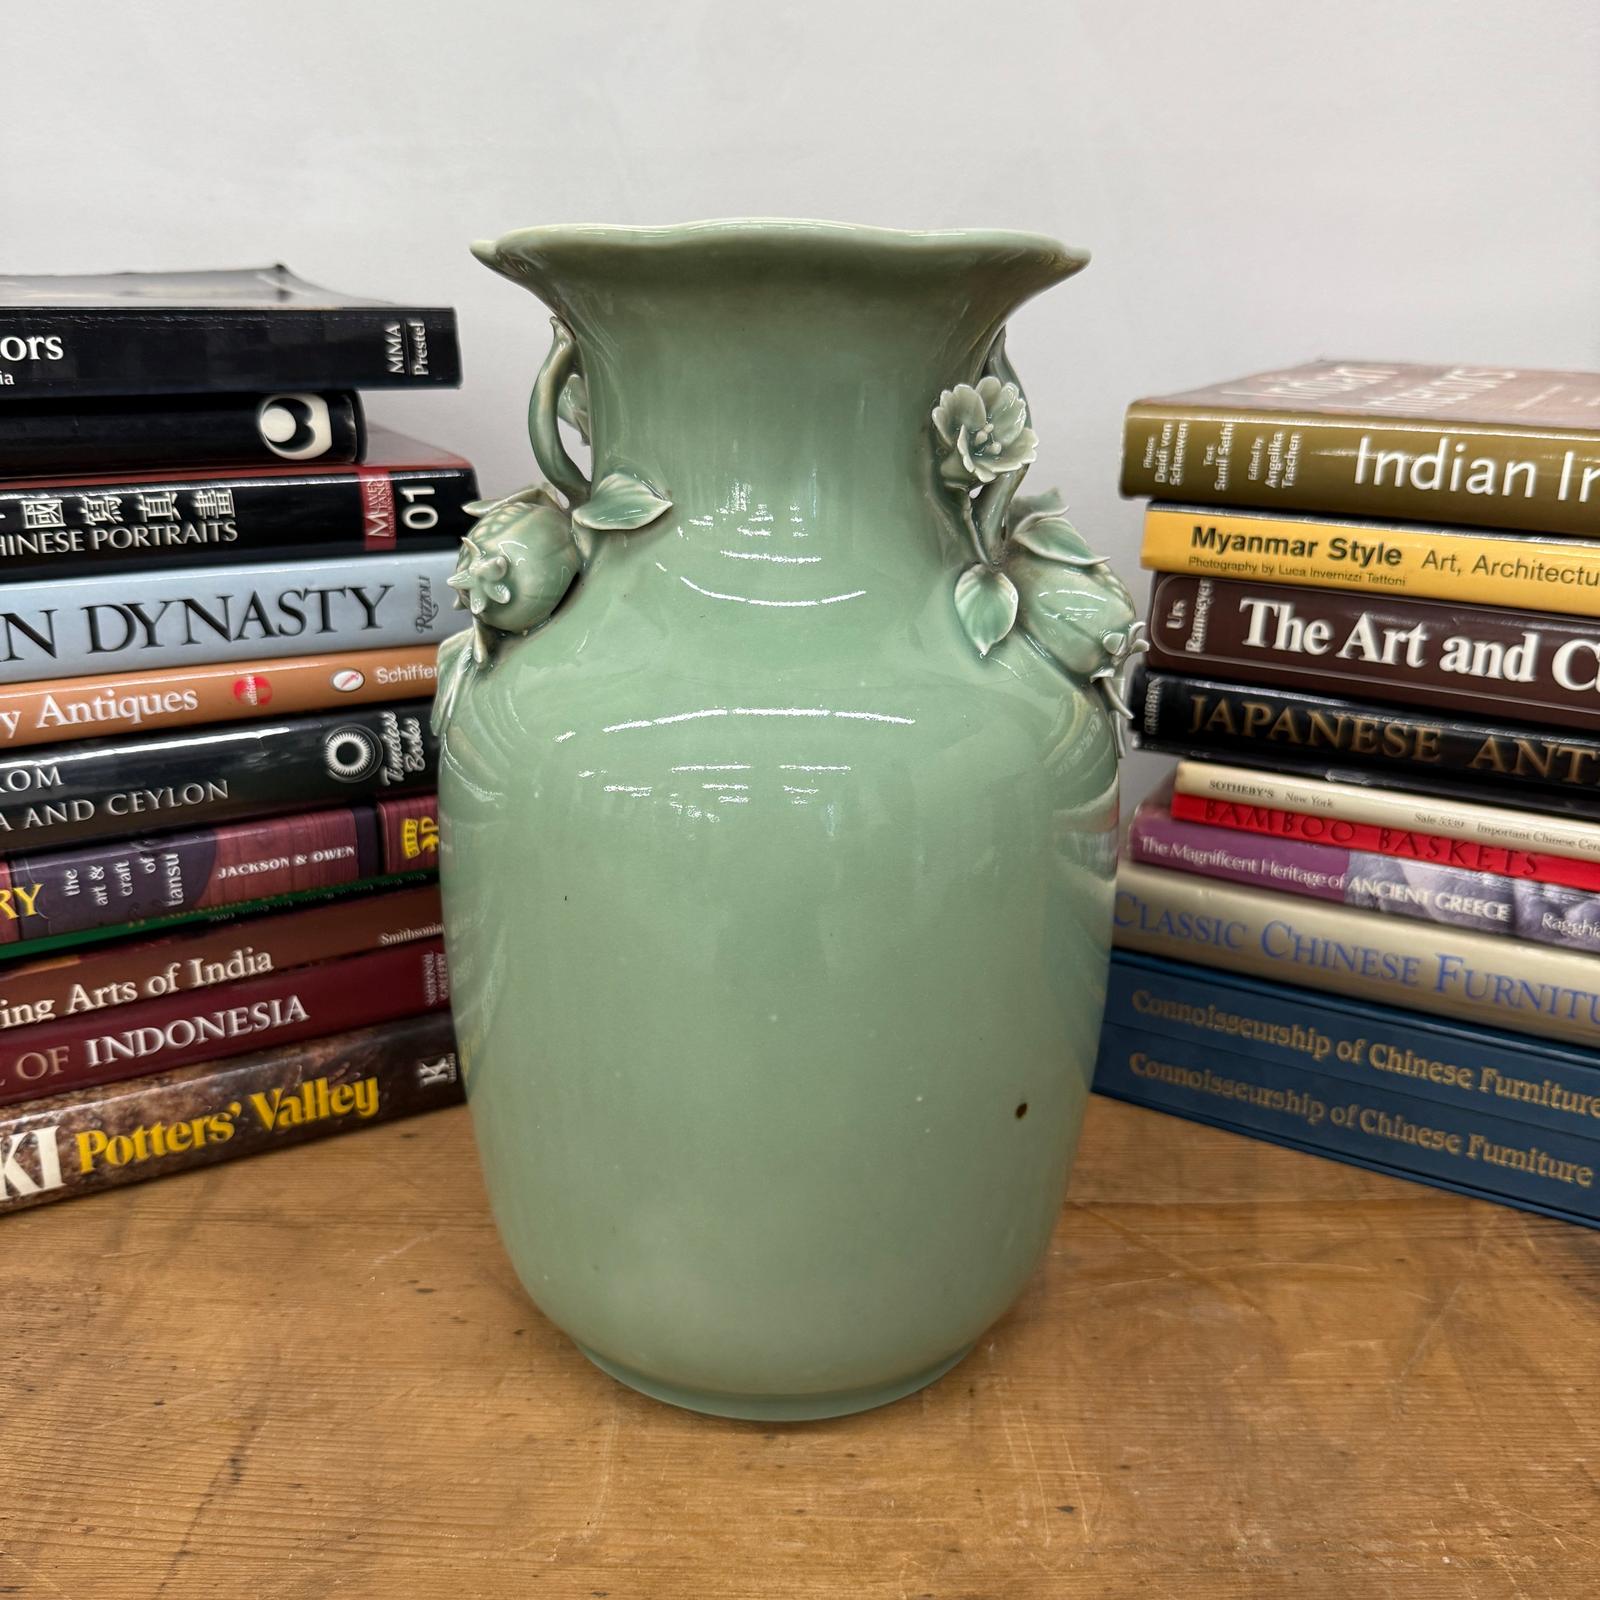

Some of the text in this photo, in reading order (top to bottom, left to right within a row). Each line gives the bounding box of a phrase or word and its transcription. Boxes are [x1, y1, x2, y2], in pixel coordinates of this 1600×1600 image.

[384, 323, 405, 374] MMA
[409, 321, 429, 375] Prestel
[1155, 421, 1174, 483] Deidi von
[1170, 420, 1188, 486] Schaewen
[1214, 421, 1234, 491] Sunil Sethi
[1248, 451, 1262, 480] Edited
[1265, 431, 1285, 488] Angelika
[1281, 432, 1302, 488] Taschen
[1354, 435, 1537, 499] Indian
[0, 487, 236, 529] 國寫真畫
[92, 520, 238, 550] PORTRAITS
[401, 486, 438, 530] 01
[1188, 556, 1406, 586] Photography by Luca Invernizzi Tettoni
[1191, 526, 1318, 557] Myanmar
[1327, 537, 1403, 568] Style
[1421, 550, 1461, 576] Art,
[0, 584, 394, 661] N DYNASTY
[1166, 599, 1187, 630] Urs
[1185, 578, 1213, 652] Ramseyer
[1239, 597, 1600, 692] The Art and C
[36, 688, 198, 728] Antiques
[1189, 693, 1441, 763] JAPANESE
[380, 711, 405, 786] Timeless
[400, 717, 426, 772] Books
[0, 766, 64, 793] OM
[24, 799, 95, 829] AND
[107, 779, 229, 816] CEYLON
[1203, 800, 1537, 876] BAMBOO BASKETS
[1208, 779, 1275, 798] SOTHEBY'S
[1285, 792, 1307, 804] New
[1311, 795, 1335, 809] York
[1414, 812, 1436, 826] Sale
[1477, 822, 1530, 841] Important
[1533, 831, 1576, 847] Chinese
[64, 868, 80, 896] the
[90, 865, 109, 906] art &
[114, 860, 133, 896] craft
[139, 857, 156, 874] of
[165, 853, 184, 907] tansu
[217, 845, 356, 879] JACKSON & OWEN
[1140, 836, 1513, 922] The Magnificent Heritage of ANCIENT GREECE
[1114, 890, 1248, 950] CLASSIC
[1261, 919, 1422, 987] CHINESE
[65, 981, 138, 1015] Arts
[146, 962, 181, 996] of
[188, 947, 275, 988] India
[16, 994, 310, 1079] OF INDONESIA
[1131, 989, 1600, 1118] Connoisseurship of Chinese Furniture
[75, 1101, 243, 1174] Potters'
[250, 1076, 380, 1134] Valley
[1129, 1053, 1595, 1187] Connoisseurship of Chinese Furniture
